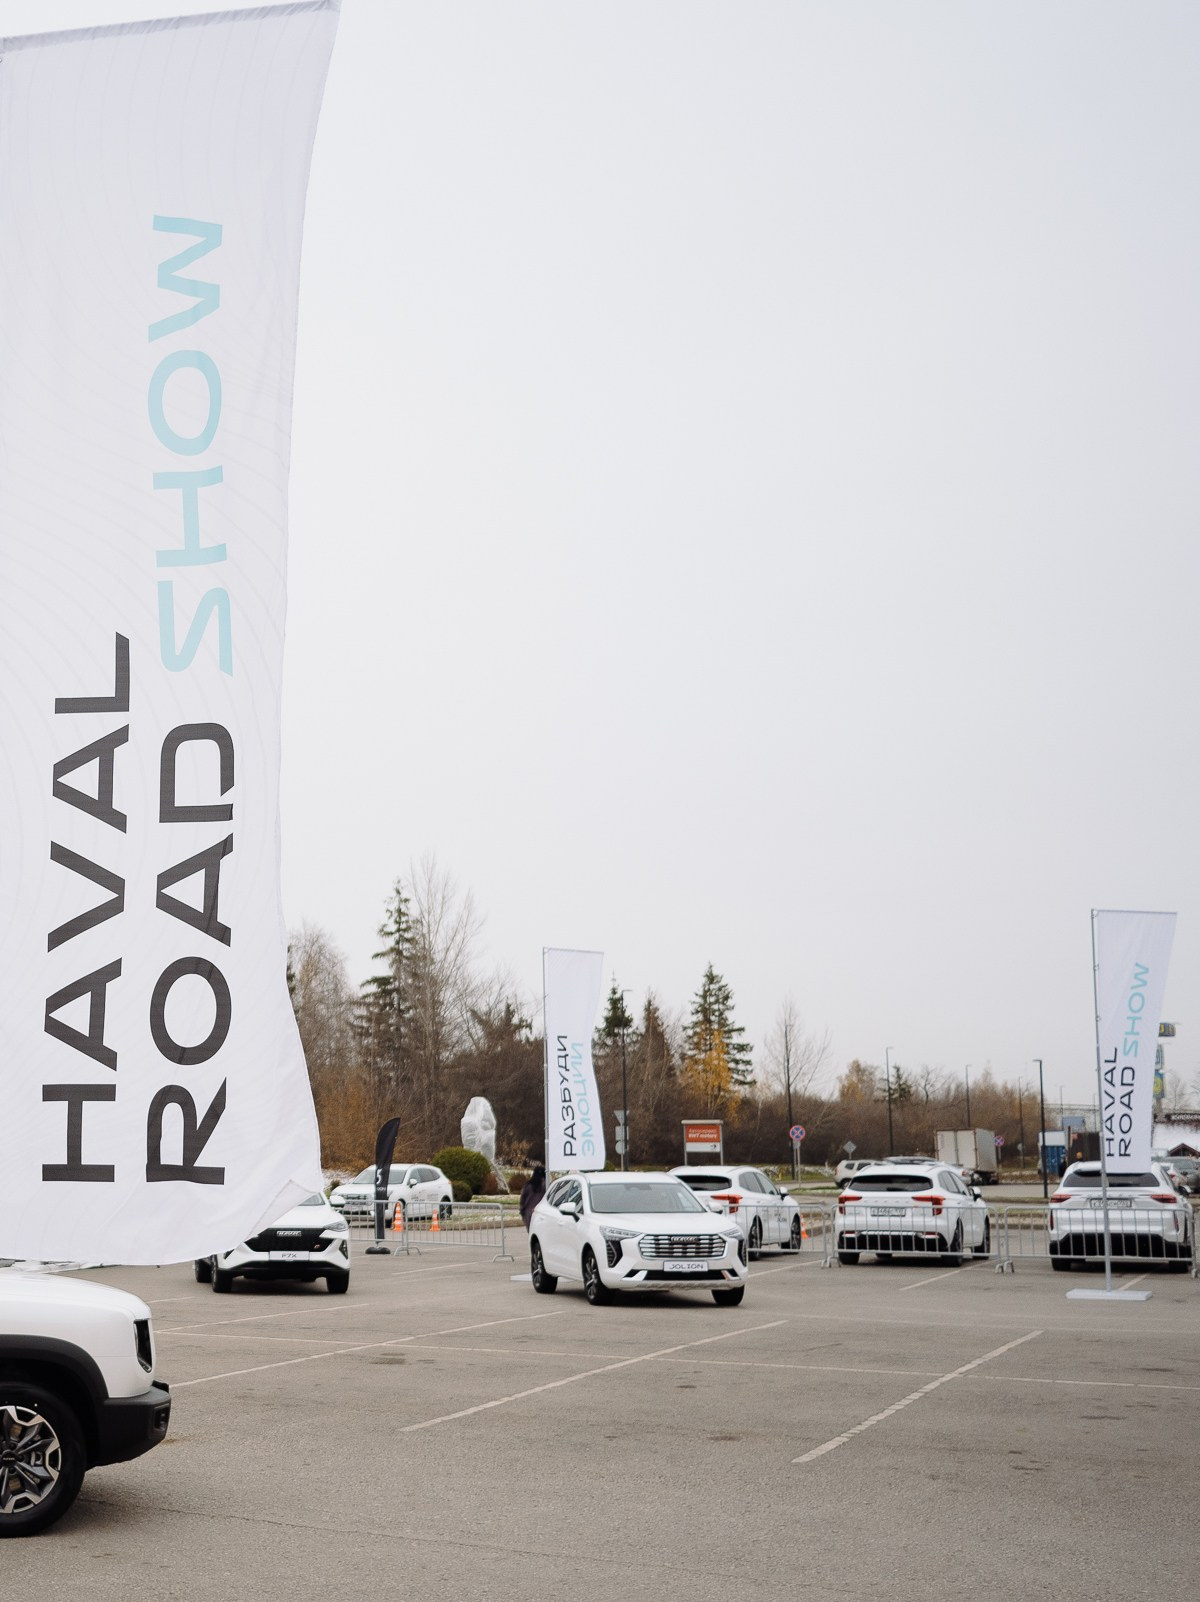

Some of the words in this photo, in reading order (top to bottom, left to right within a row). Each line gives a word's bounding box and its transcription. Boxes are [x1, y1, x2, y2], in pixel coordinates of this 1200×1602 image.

[147, 214, 234, 678] SHOW
[41, 632, 130, 1183] HAVAL
[145, 722, 235, 1185] ROAD
[1122, 962, 1151, 1058] SHOW
[557, 1035, 577, 1157] РАЗБУДИ
[569, 1042, 596, 1158] ЭМОЦИИ
[1104, 1047, 1118, 1157] HAVAL
[1117, 1066, 1136, 1157] ROAD
